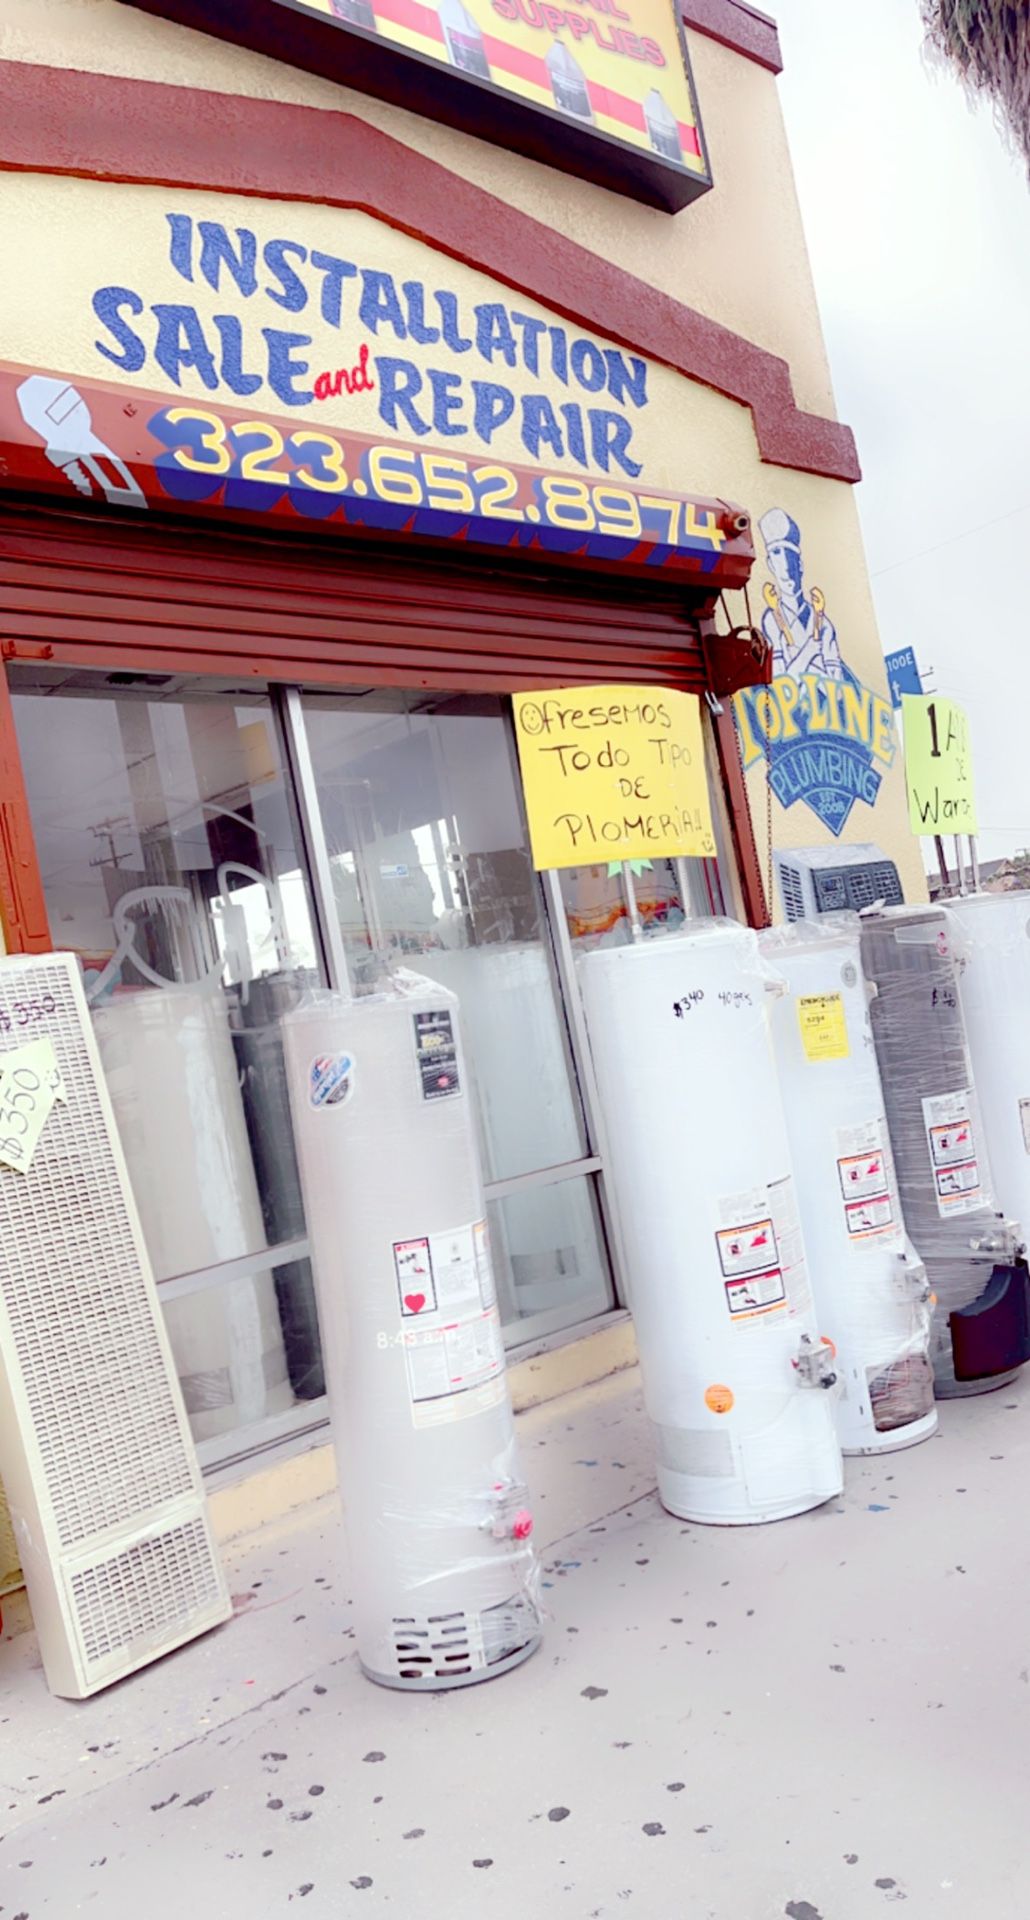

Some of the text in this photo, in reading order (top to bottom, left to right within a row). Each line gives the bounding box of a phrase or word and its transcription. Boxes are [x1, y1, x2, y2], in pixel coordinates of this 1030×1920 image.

[491, 0, 667, 67] SUPPLIES
[166, 213, 648, 408] INSTALLATION
[93, 286, 644, 478] SALE and REPAIR
[163, 406, 726, 552] 323.652.8974
[619, 776, 651, 799] DE
[769, 749, 880, 805] PLUMBING
